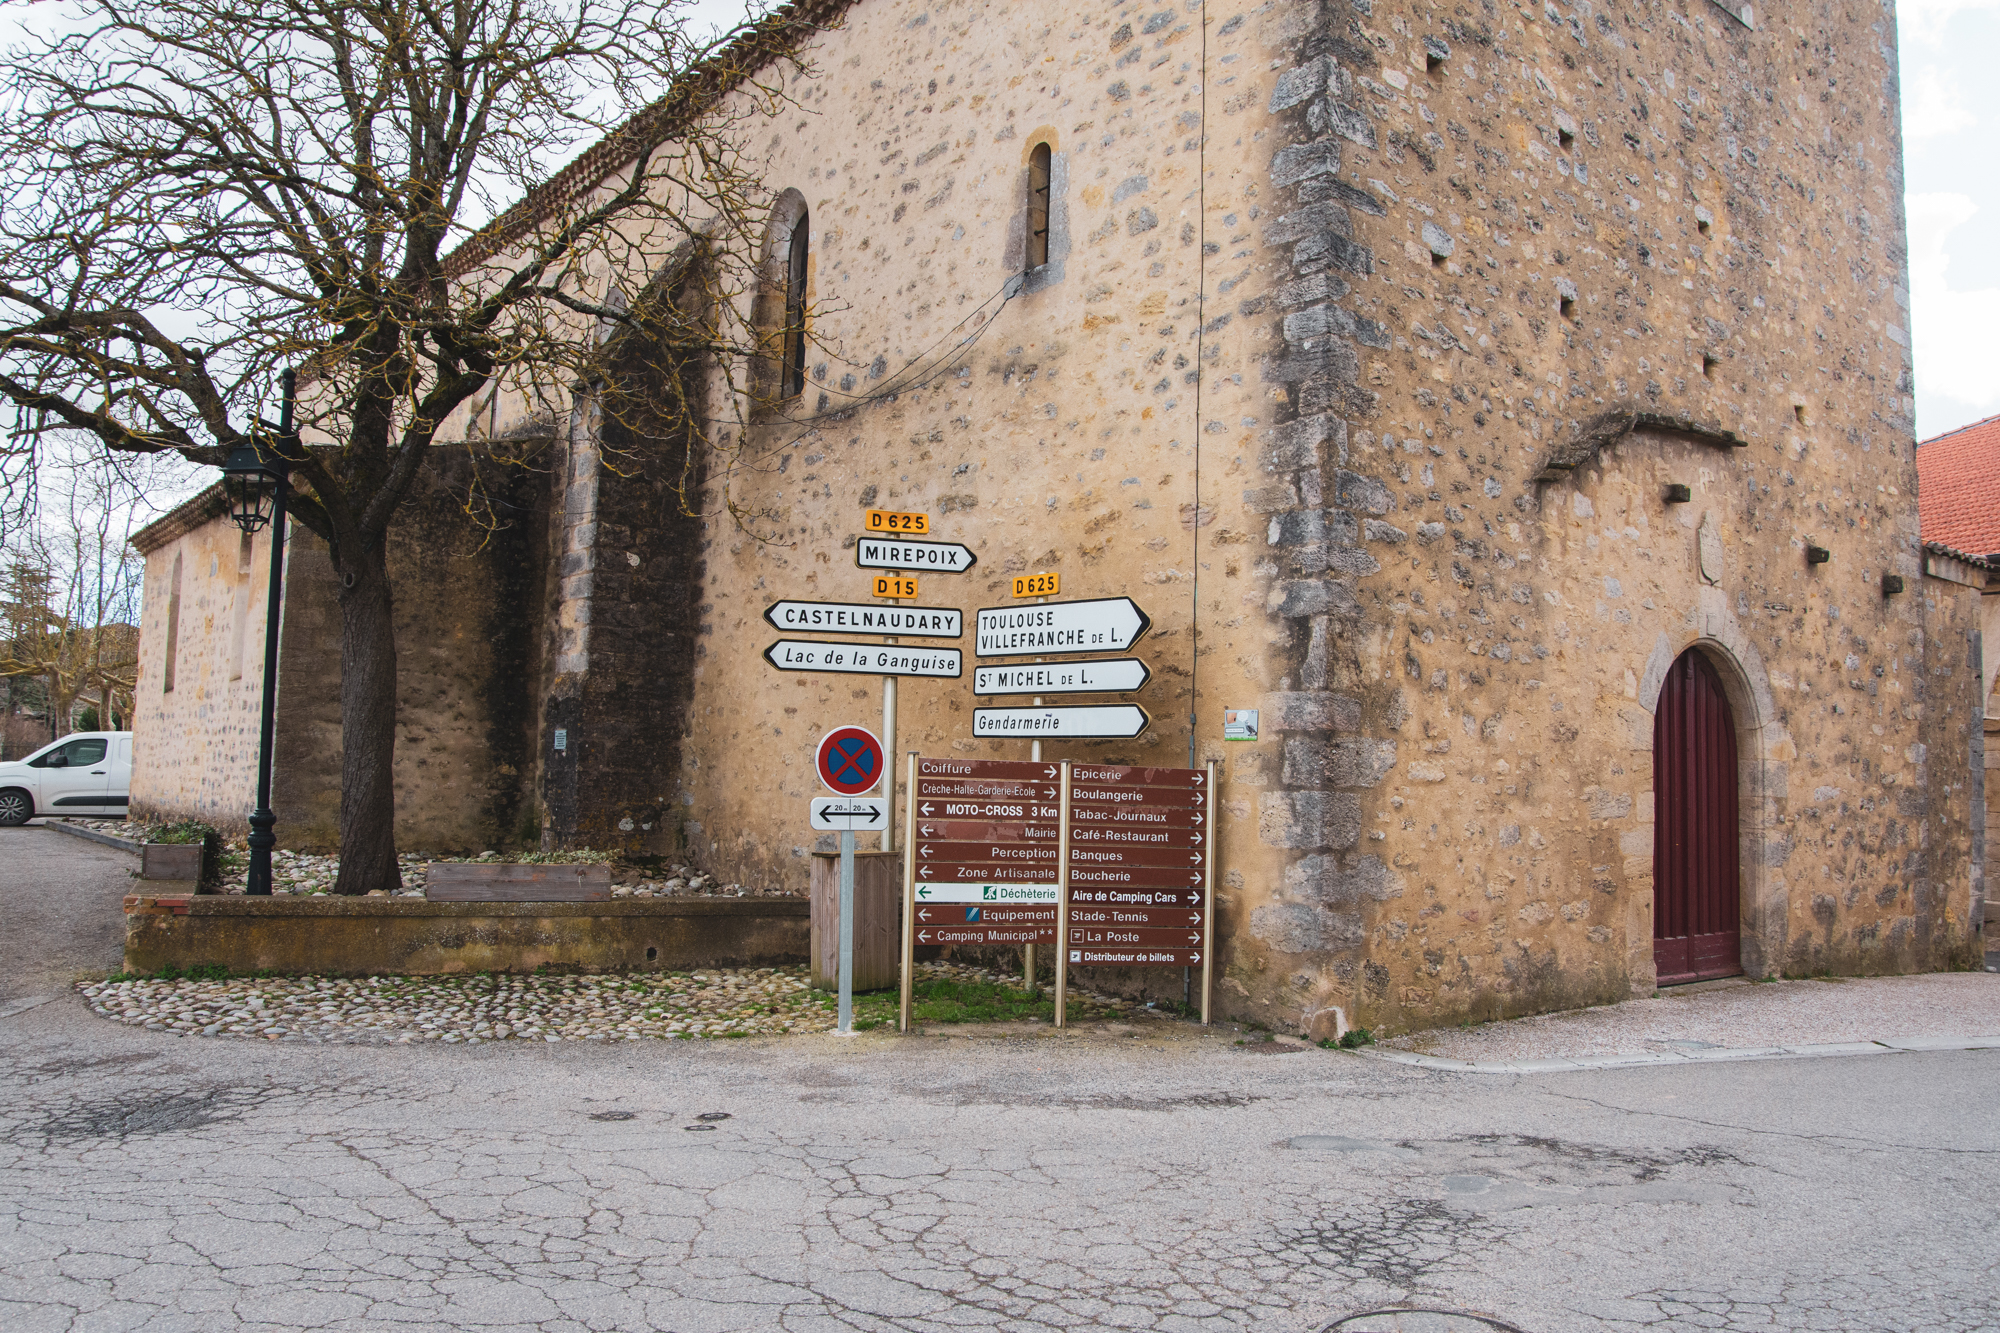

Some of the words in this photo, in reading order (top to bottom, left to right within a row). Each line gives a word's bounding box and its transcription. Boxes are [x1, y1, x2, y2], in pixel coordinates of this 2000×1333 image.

[872, 513, 882, 527] D
[888, 514, 925, 530] 625
[865, 545, 958, 566] MIREPOIX
[877, 579, 888, 593] D
[894, 580, 915, 596] 15
[1016, 579, 1024, 594] D
[1027, 576, 1055, 593] 625
[785, 608, 955, 631] CASTELNAUDARY
[982, 611, 1054, 631] TOULOUSE
[981, 629, 1085, 650] VILLEFRANCHE
[1091, 633, 1104, 644] DE
[1110, 627, 1123, 643] L.
[785, 647, 815, 664] Lac
[824, 650, 844, 665] de
[852, 651, 868, 666] la
[877, 652, 956, 673] Ganguise
[998, 671, 1053, 688] MICHEL
[1061, 675, 1073, 685] DE
[1081, 669, 1094, 684] L.
[979, 714, 1060, 730] Gendarmerie
[921, 762, 972, 775] Coiffure
[1073, 768, 1122, 781] Epicerie
[1073, 788, 1143, 803] Boulangerie
[946, 803, 1023, 816] MOTO-CROSS
[1031, 807, 1038, 817] 3
[1040, 806, 1058, 817] Km
[1073, 808, 1167, 823] Tabac-Journaux
[1024, 827, 1057, 838] Mairie
[1073, 828, 1169, 842] Café-Restaurant
[991, 847, 1056, 860] Perception
[1071, 849, 1123, 862] Banques
[957, 867, 989, 878] Zone
[994, 867, 1056, 879] Artisanale
[1071, 869, 1131, 882] Boucherie
[1072, 890, 1093, 901] Aire
[1094, 890, 1107, 901] de
[1109, 891, 1152, 905] Camping
[1154, 892, 1177, 903] Cars
[982, 909, 1055, 922] Equipement
[1071, 910, 1149, 922] Stade-Tennis
[937, 930, 984, 943] Camping
[1087, 931, 1101, 942] La
[1107, 931, 1140, 942] Poste
[1084, 951, 1134, 962] Distributeur
[1136, 952, 1147, 962] de
[1149, 952, 1175, 962] billets
